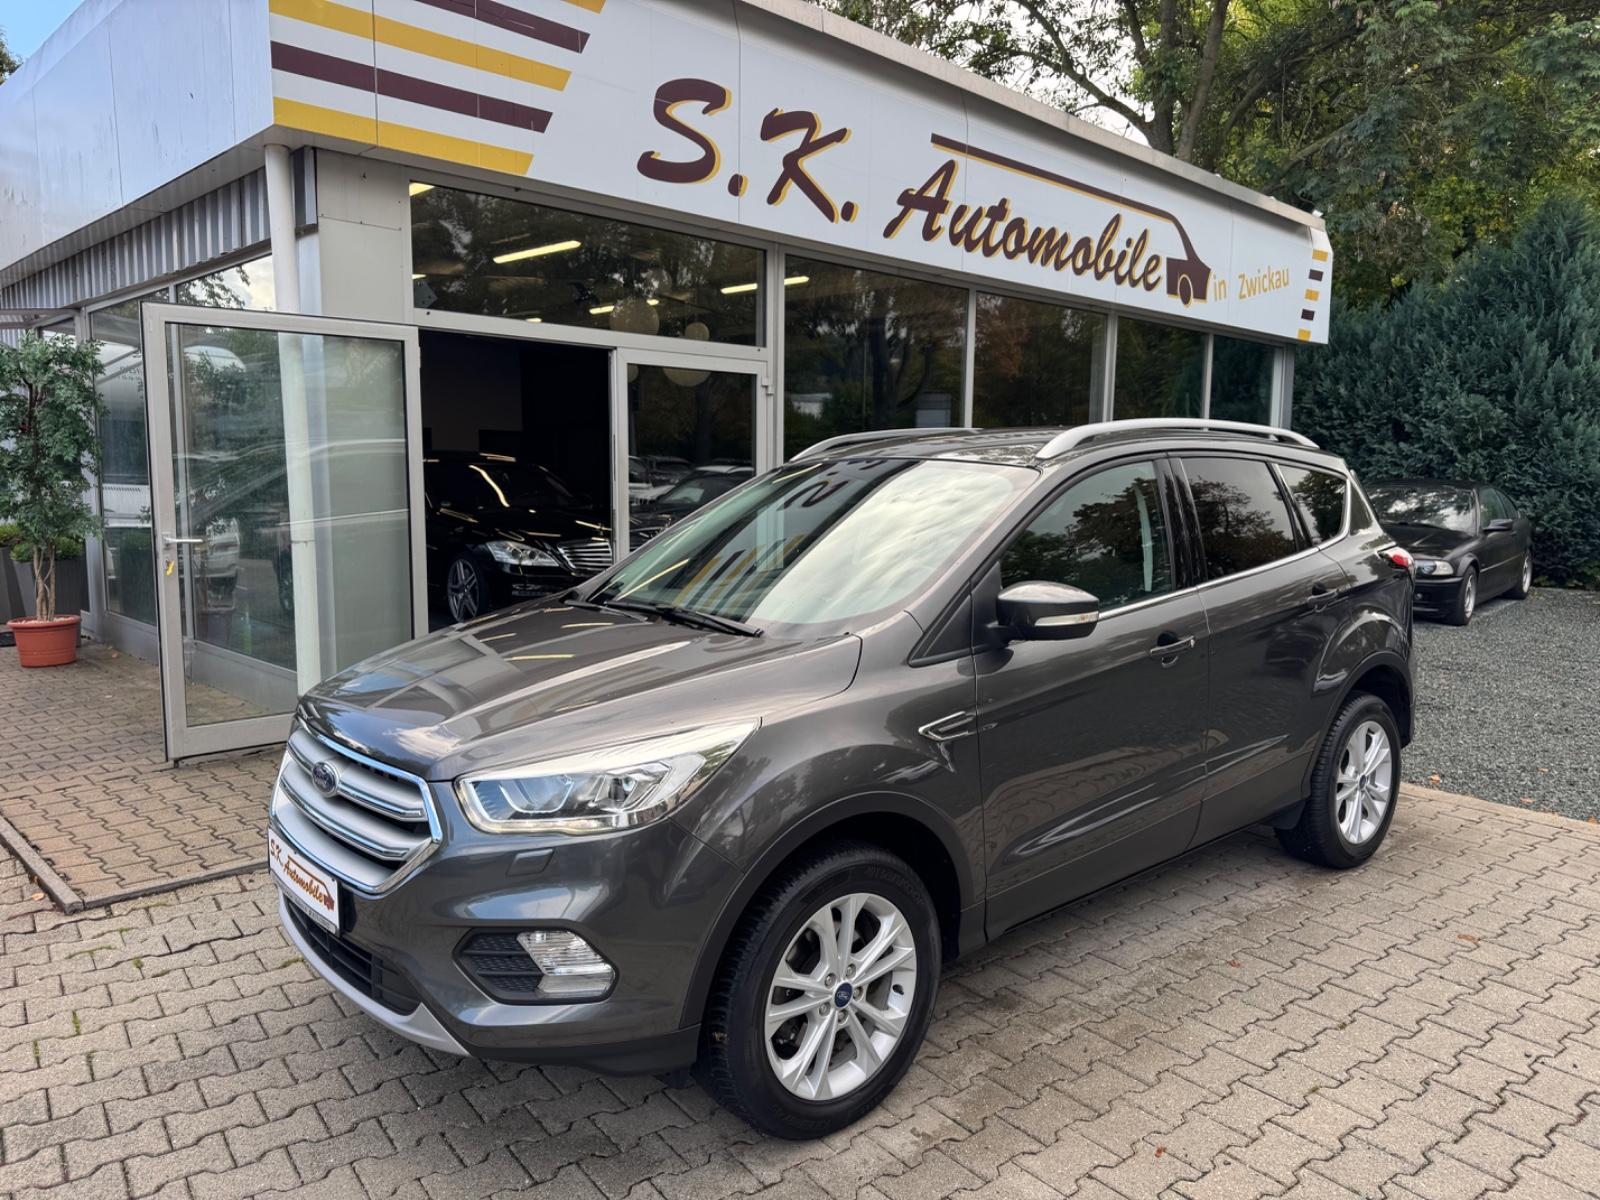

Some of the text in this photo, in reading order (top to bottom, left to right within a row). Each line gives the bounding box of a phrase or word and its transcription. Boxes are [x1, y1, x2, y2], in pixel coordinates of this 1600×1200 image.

[636, 77, 1163, 292] S.K. Automobile
[1212, 264, 1290, 302] in Zwickau
